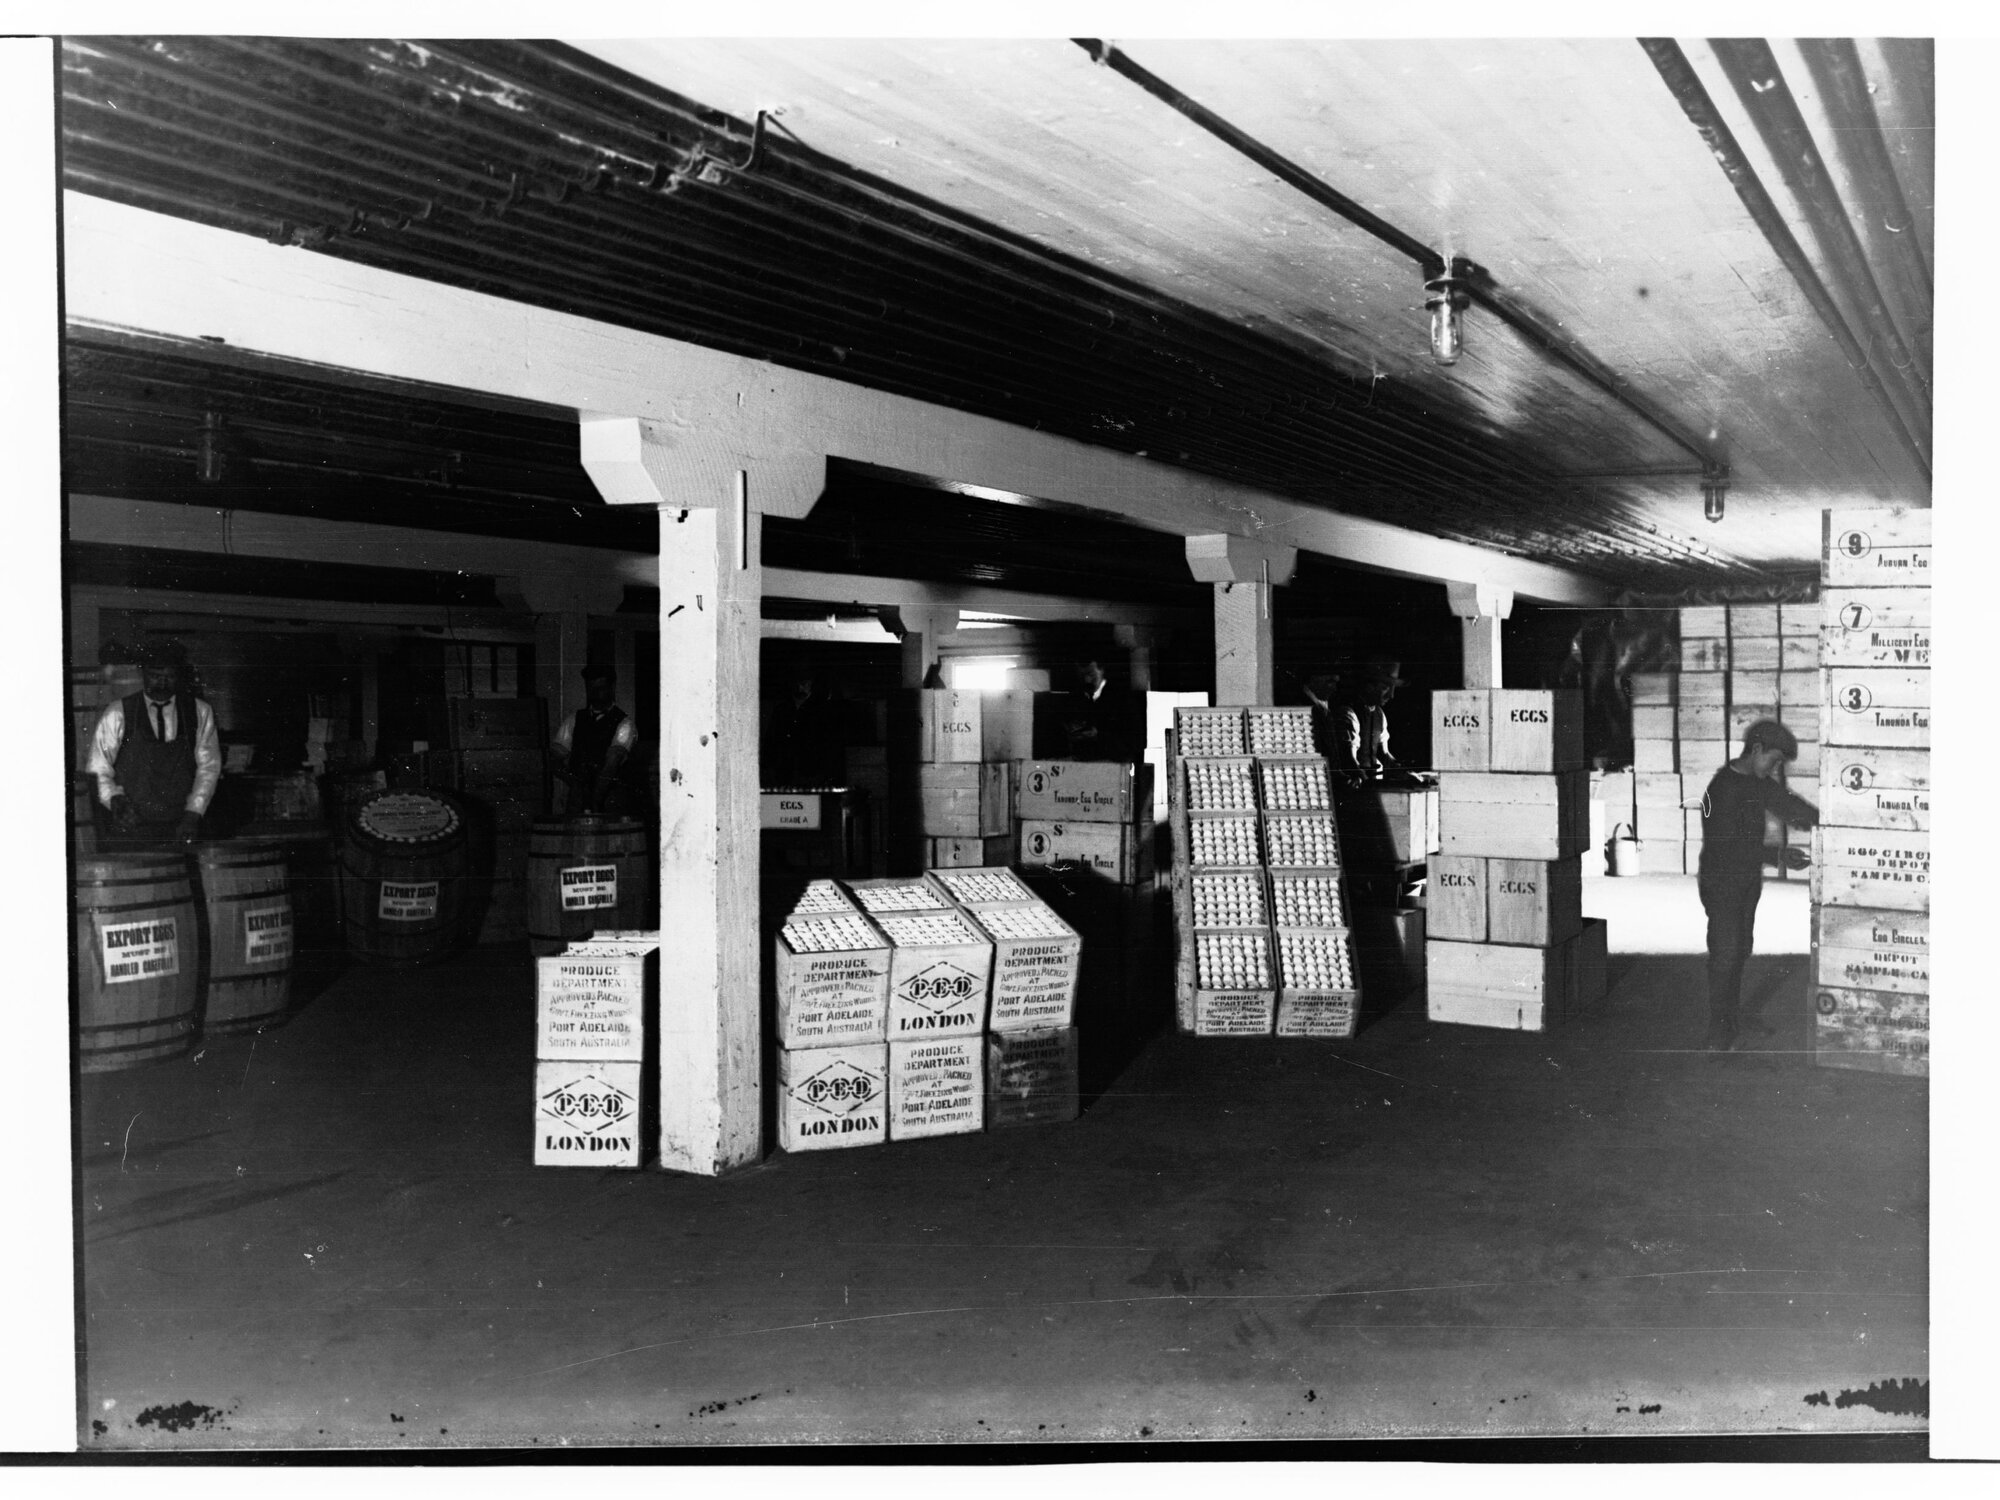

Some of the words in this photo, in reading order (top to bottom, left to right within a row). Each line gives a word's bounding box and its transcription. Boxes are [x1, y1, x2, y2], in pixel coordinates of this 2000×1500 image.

[1848, 533, 1862, 555] 9
[1851, 606, 1863, 628] 7
[1848, 688, 1862, 710] 3
[1443, 715, 1480, 728] EGGS
[1510, 709, 1549, 723] EGGS
[943, 722, 972, 733] EGGS
[1033, 773, 1043, 792] 3
[1850, 767, 1863, 790] 3
[780, 800, 804, 810] EGGS
[1034, 834, 1045, 854] 3
[1440, 873, 1476, 887] EGGS
[1499, 881, 1536, 894] EGGS
[106, 927, 151, 948] EXPORT
[152, 923, 175, 943] EGGS
[1012, 945, 1063, 956] PRODUCE
[811, 959, 868, 971] PRODUCE
[1004, 955, 1069, 967] DEPARTMENT
[560, 966, 620, 976] PRODUCE
[803, 969, 874, 983] DEPARTMENT
[553, 979, 628, 988] DEPARTMENT
[832, 992, 843, 1000] AT
[997, 996, 1021, 1006] PORT
[1023, 992, 1067, 1004] ADELAIDE
[584, 1002, 596, 1010] AT
[996, 1009, 1020, 1018] SOUTH
[1023, 1005, 1065, 1016] AUSTRALIA
[798, 1012, 823, 1023] PORT
[826, 1009, 874, 1021] ADELAIDE
[900, 1013, 976, 1031] LONDON
[549, 1022, 575, 1032] PORT
[580, 1021, 631, 1032] ADELAIDE
[796, 1026, 823, 1036] SOUTH
[827, 1020, 873, 1034] AUSTRALIA
[548, 1038, 577, 1047] SOUTH
[581, 1037, 630, 1048] AUSTRALIA
[911, 1045, 963, 1058] PRODUCE
[904, 1056, 970, 1070] DEPARTMENT
[931, 1080, 943, 1088] AT
[902, 1102, 924, 1113] PORT
[929, 1097, 973, 1111] ADELAIDE
[930, 1111, 973, 1124] AUSTRALIA
[800, 1116, 879, 1136] LONDON
[546, 1136, 631, 1151] LONDON
